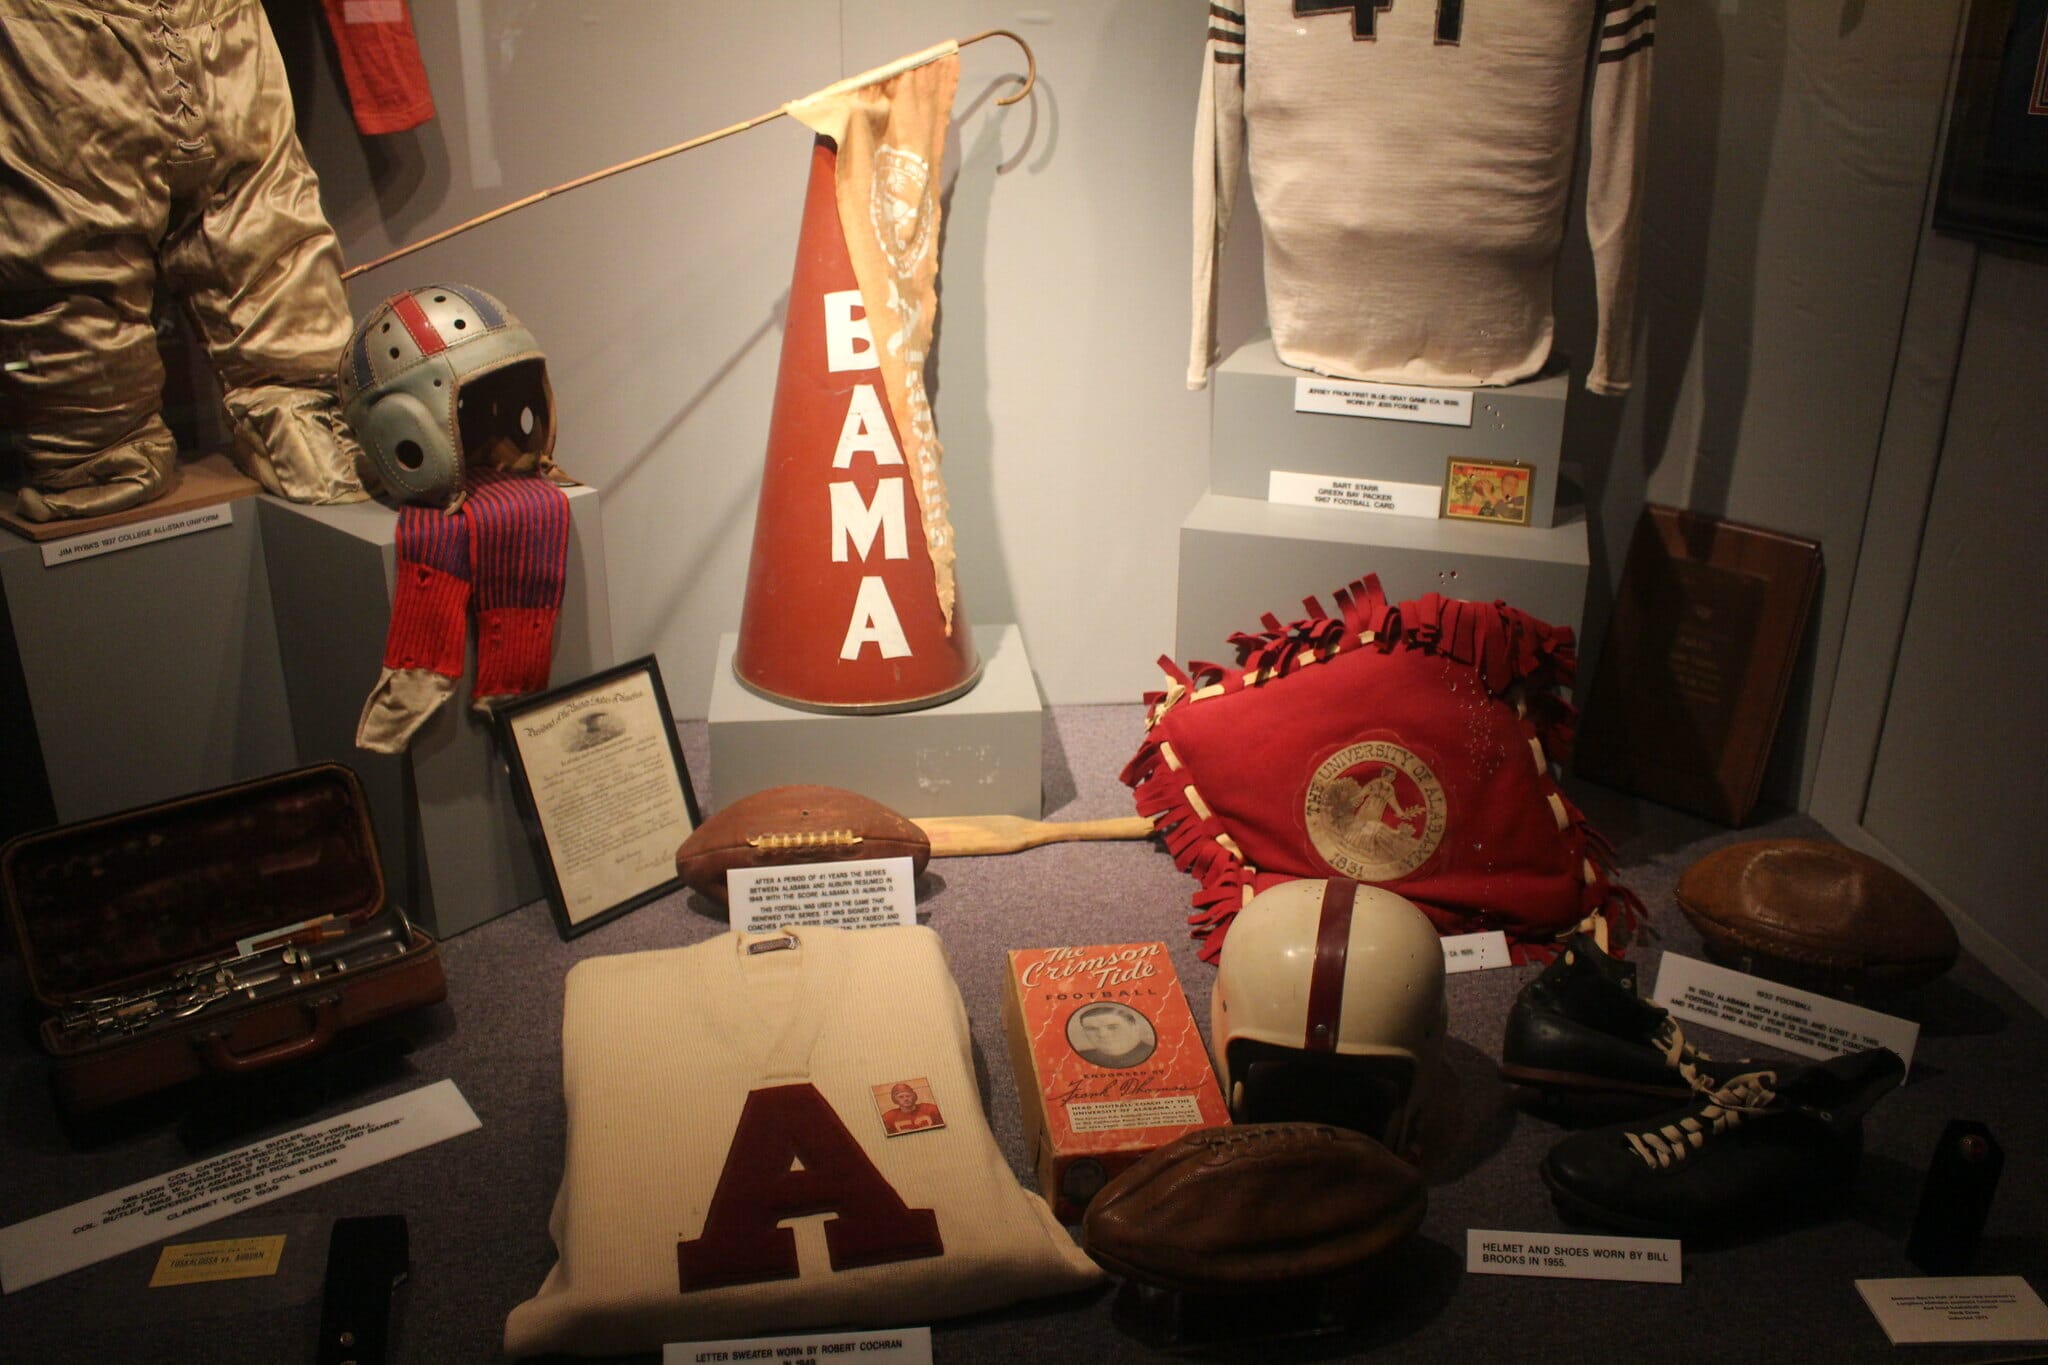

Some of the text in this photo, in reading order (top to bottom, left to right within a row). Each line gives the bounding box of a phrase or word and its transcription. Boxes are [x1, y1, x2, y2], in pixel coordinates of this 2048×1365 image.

[824, 290, 913, 661] BAMA
[1318, 488, 1343, 496] GREEN
[1333, 498, 1370, 507] FOOTBALL
[57, 547, 72, 556] JIM
[117, 529, 152, 543] COLLEGE
[185, 514, 218, 527] UNIFORM
[1307, 781, 1324, 816] THE
[1317, 744, 1414, 779] UNIVERSITY
[1412, 764, 1432, 782] OF
[1328, 852, 1364, 878] 1831
[781, 883, 810, 891] ALABAMA
[1022, 943, 1160, 988] Crimson
[1043, 946, 1085, 964] The
[1091, 963, 1156, 989] Tide
[1045, 988, 1157, 1001] FOOTBALL
[1775, 994, 1813, 1012] FOOTBALL
[1670, 998, 1685, 1006] AND
[1686, 1003, 1718, 1016] PLAYERS
[1721, 1013, 1736, 1022] AND
[1737, 1018, 1758, 1029] ALSO
[1760, 1025, 1781, 1035] LISTS
[1783, 1031, 1815, 1045] SCORES
[1683, 993, 1719, 1008] FOOTBALL
[1722, 1004, 1743, 1015] FROM
[1746, 1011, 1763, 1020] THAT
[1766, 1017, 1786, 1027] YEAR
[1797, 1026, 1827, 1040] SIGNED
[1828, 1035, 1839, 1043] BY
[1716, 994, 1750, 1008] ALABAMA
[1753, 1005, 1771, 1014] WON
[1781, 1013, 1808, 1025] GAMES
[1811, 1021, 1827, 1030] AND
[1828, 1026, 1848, 1037] LOST
[1862, 1036, 1879, 1046] THIS
[1083, 1071, 1147, 1079] ENDORSED
[101, 1205, 145, 1223] BUTLER
[149, 1196, 173, 1207] WAS
[255, 1158, 288, 1172] MUSIC
[291, 1140, 341, 1160] PROGRAM
[344, 1132, 364, 1142] AND
[140, 1192, 166, 1203] PAUL
[187, 1172, 227, 1188] BRYANT
[231, 1163, 253, 1173] WAS
[274, 1141, 320, 1159] ALABAMA
[194, 1152, 248, 1172] CARLETON
[122, 1160, 241, 1203] MILLION DOLLAR BAND
[143, 1144, 346, 1215] UNIVERSITY PRESIDENT ROGER SAYERS
[166, 1199, 218, 1220] CLARINET
[222, 1189, 251, 1202] USED
[298, 1159, 337, 1175] BUTLER
[677, 1082, 944, 1294] A
[1482, 1242, 1669, 1262] HELMET AND SHOES WORN BY BILL
[1482, 1254, 1567, 1267] BROOKS IN 1955.
[695, 1340, 902, 1363] LETTER SWEATER WORN BY ROBERT COCHRAN
